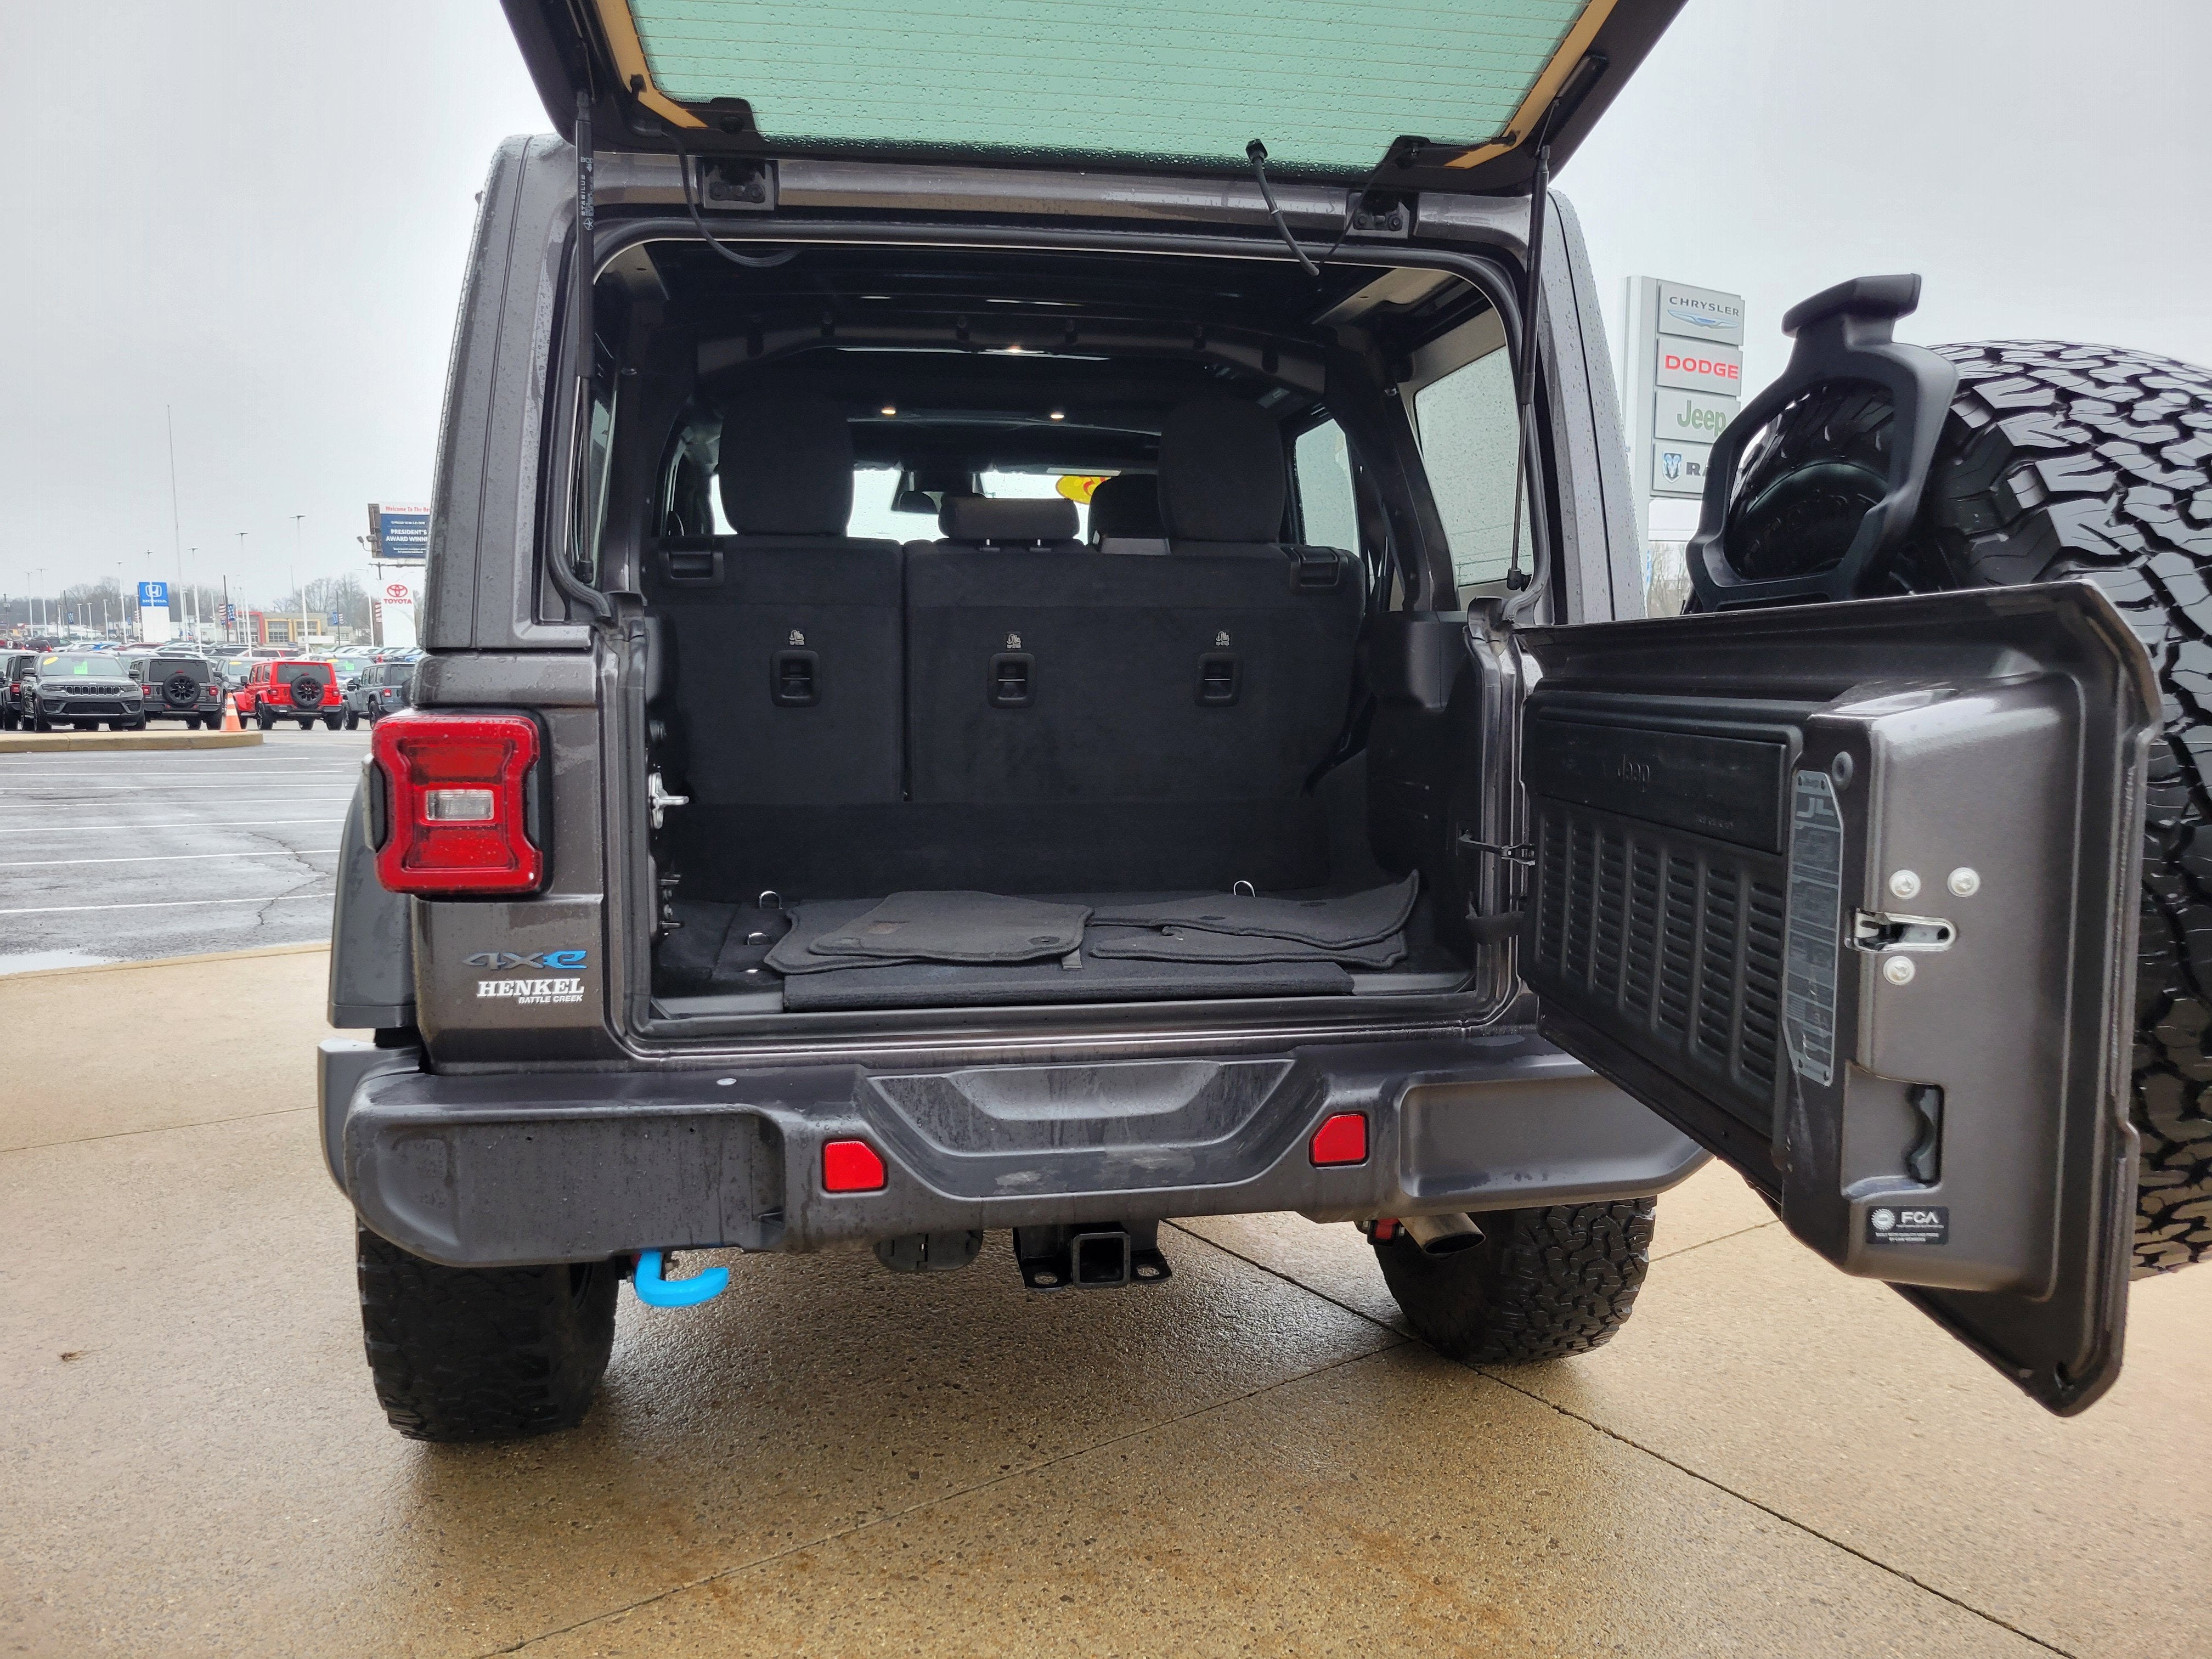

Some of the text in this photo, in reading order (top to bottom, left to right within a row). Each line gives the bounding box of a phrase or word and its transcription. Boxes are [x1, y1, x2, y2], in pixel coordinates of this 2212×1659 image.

[1669, 297, 1740, 317] CHRYSLER
[1665, 355, 1739, 379] DODGE
[1677, 400, 1726, 437] Jeep
[477, 978, 585, 997] HENKEL
[1901, 1211, 1939, 1223] FCA
